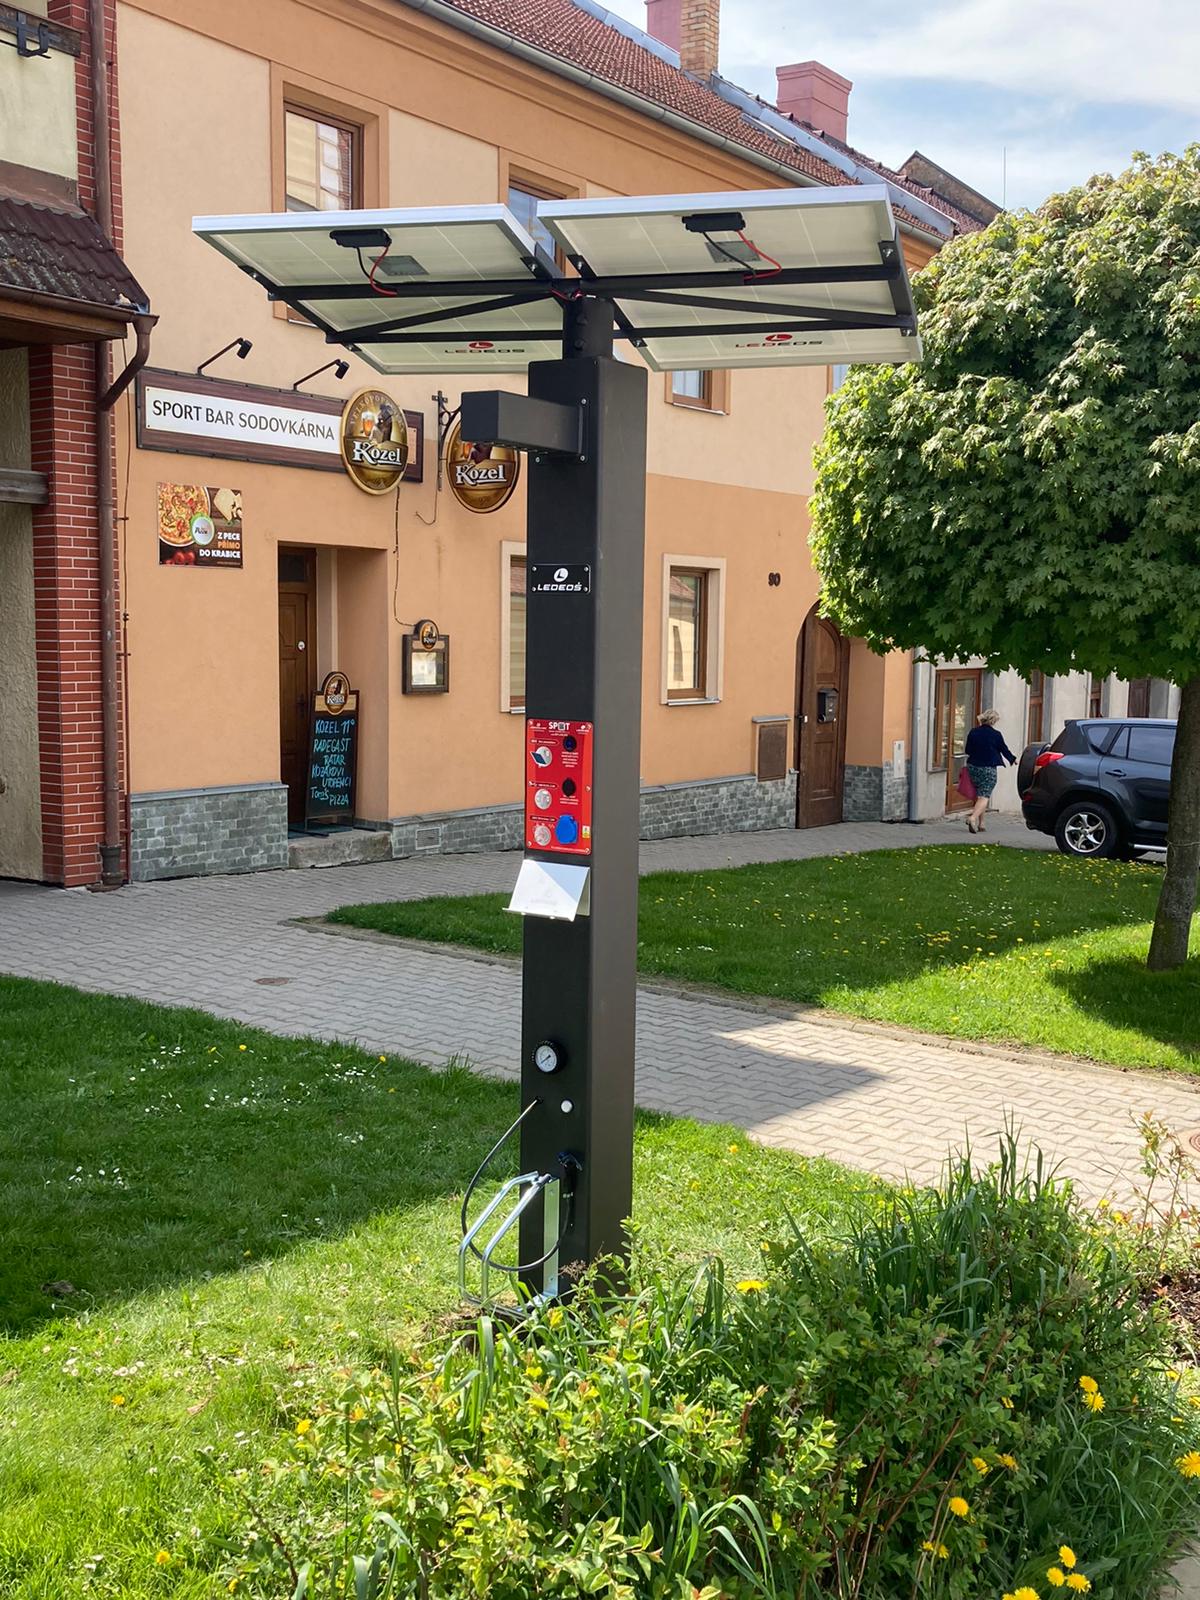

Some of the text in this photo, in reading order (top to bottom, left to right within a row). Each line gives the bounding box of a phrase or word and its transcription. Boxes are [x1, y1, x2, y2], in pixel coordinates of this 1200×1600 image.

[152, 399, 335, 440] SPORT BAR SODOVKÁRNA
[352, 440, 402, 466] Kozel
[455, 464, 507, 486] Kozel
[217, 532, 240, 541] Z PECE
[217, 541, 240, 549] PŘÍMO
[199, 549, 241, 559] DO KRABICE
[768, 572, 781, 587] 90
[315, 719, 339, 735] KOZEL
[313, 737, 352, 753] RADEGAST
[329, 793, 349, 806] PIZZA
